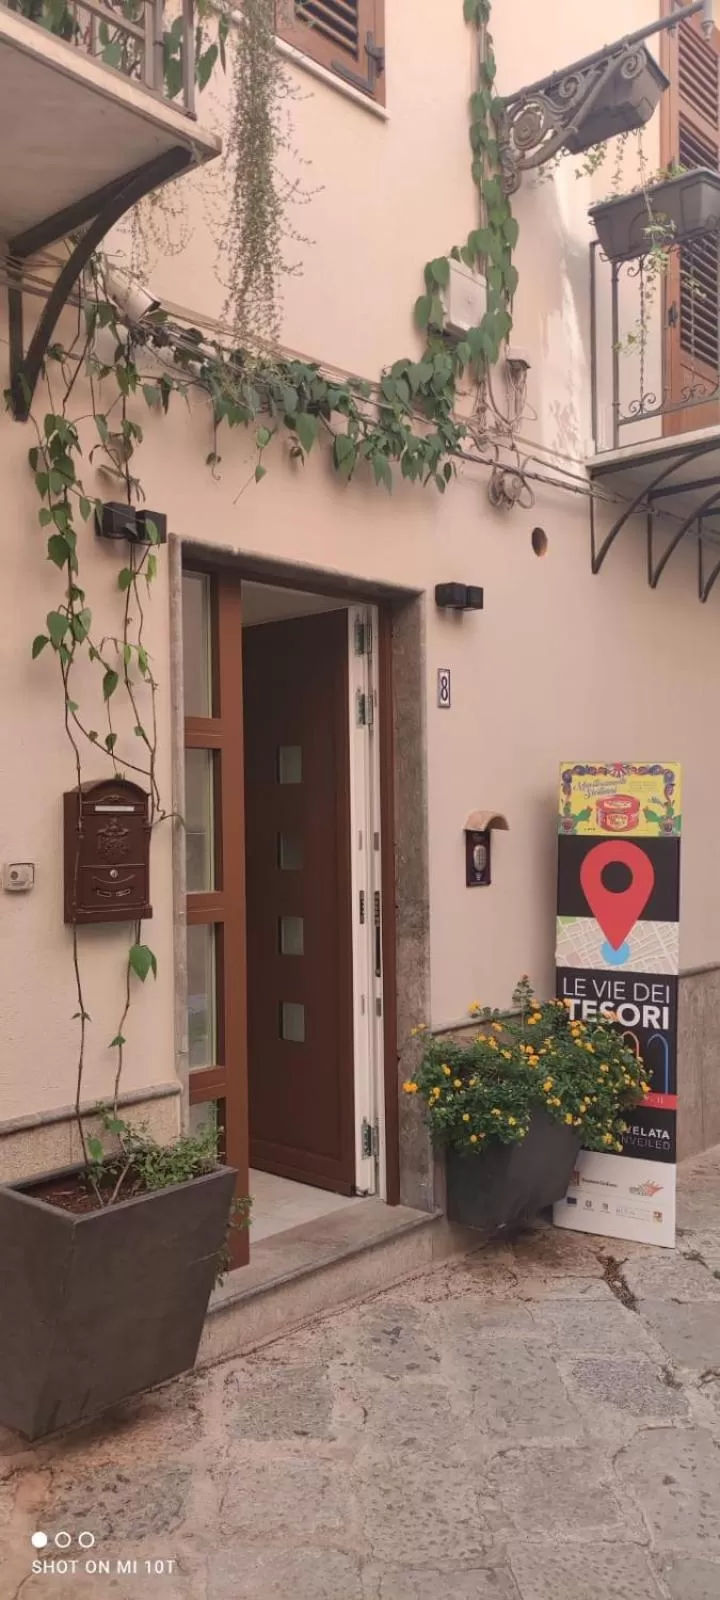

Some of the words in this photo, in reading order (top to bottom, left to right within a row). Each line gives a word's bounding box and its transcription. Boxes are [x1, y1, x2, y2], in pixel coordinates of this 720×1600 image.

[441, 676, 448, 701] 8
[563, 977, 587, 997] LE
[592, 979, 626, 1000] VIE
[633, 982, 670, 1004] DEI
[565, 999, 669, 1030] TESORI
